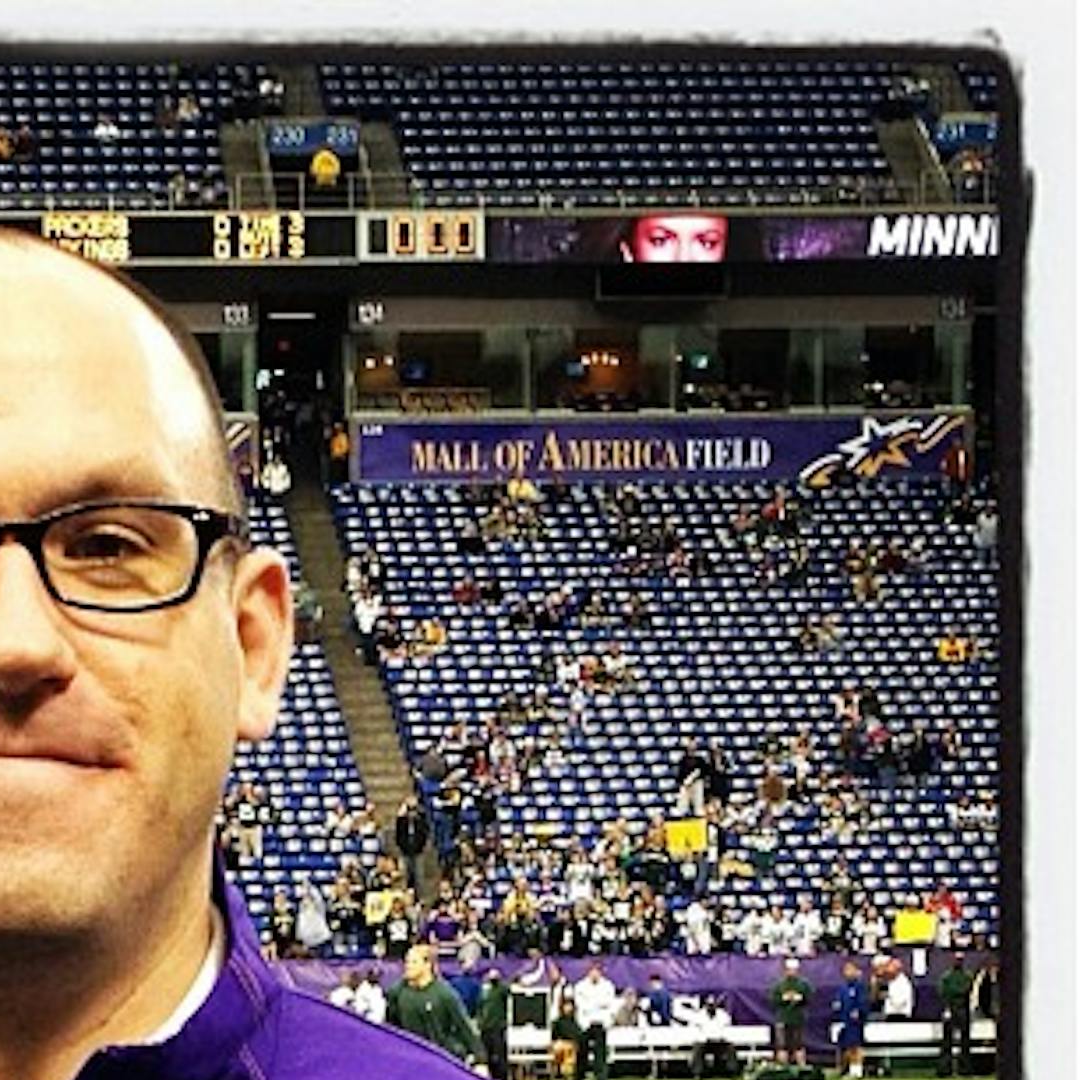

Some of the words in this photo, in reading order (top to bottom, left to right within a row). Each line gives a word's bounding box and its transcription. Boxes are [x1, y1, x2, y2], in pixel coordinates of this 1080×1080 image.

[411, 439, 489, 472] MALL
[495, 440, 534, 472] OF
[538, 430, 680, 472] AMERICA
[686, 439, 771, 471] FIELD
